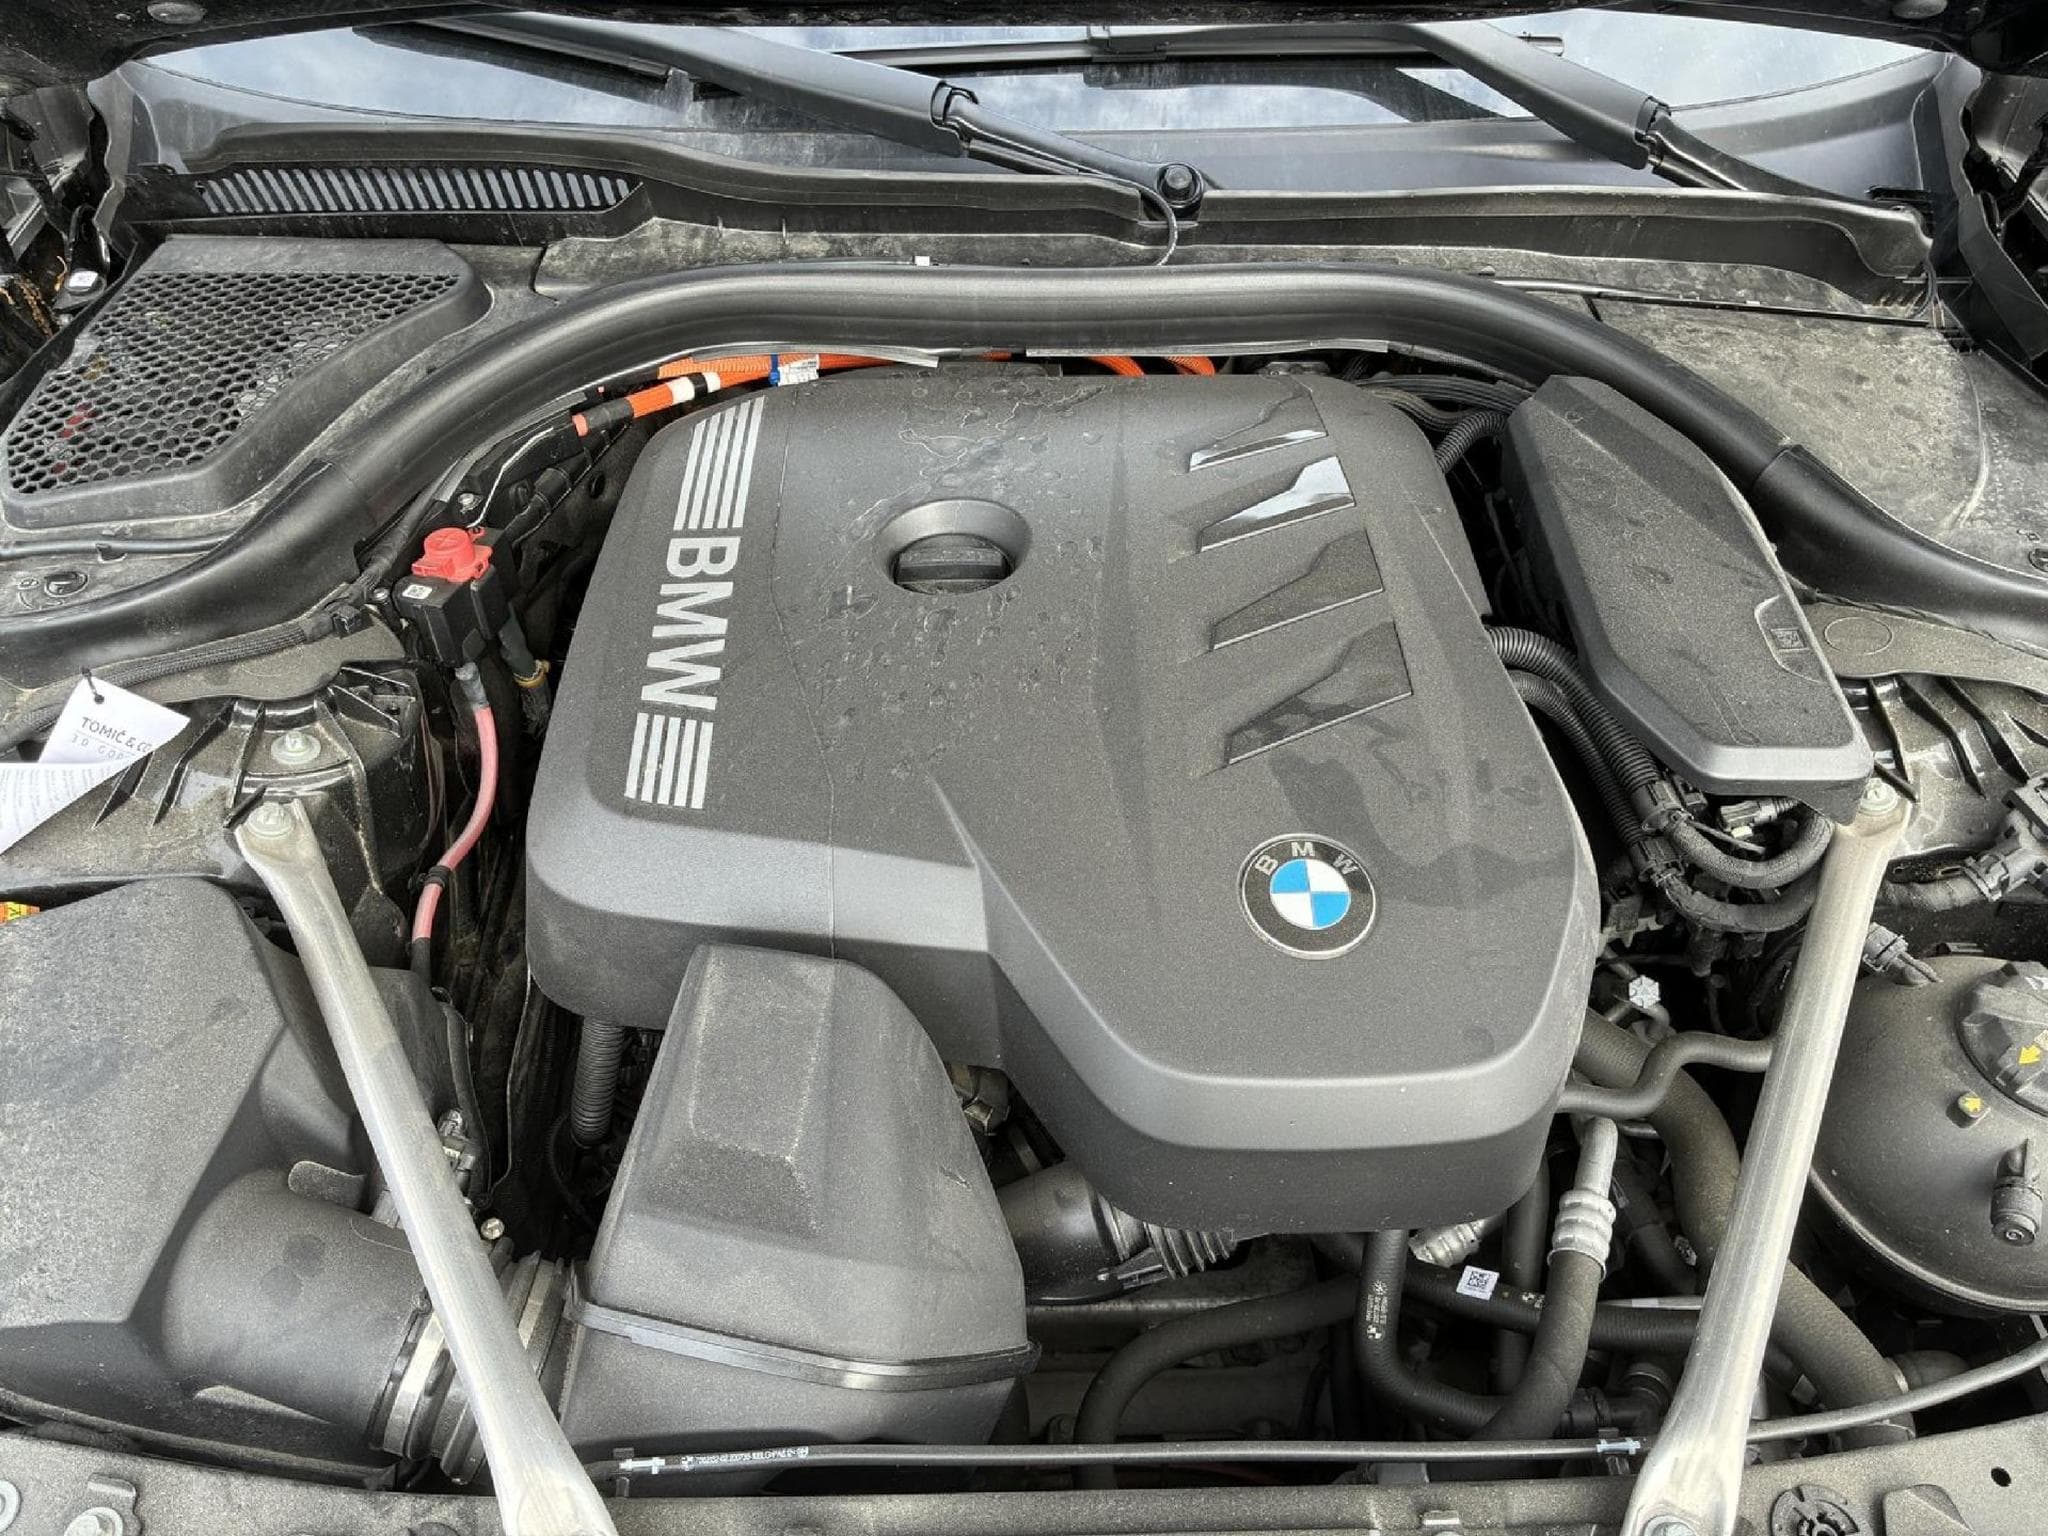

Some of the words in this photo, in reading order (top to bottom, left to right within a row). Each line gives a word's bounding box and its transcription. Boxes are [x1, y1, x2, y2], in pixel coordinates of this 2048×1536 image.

[640, 536, 741, 710] BMW
[82, 716, 126, 743] TOMIĆ
[125, 736, 137, 748] &
[1254, 841, 1358, 876] BMW
